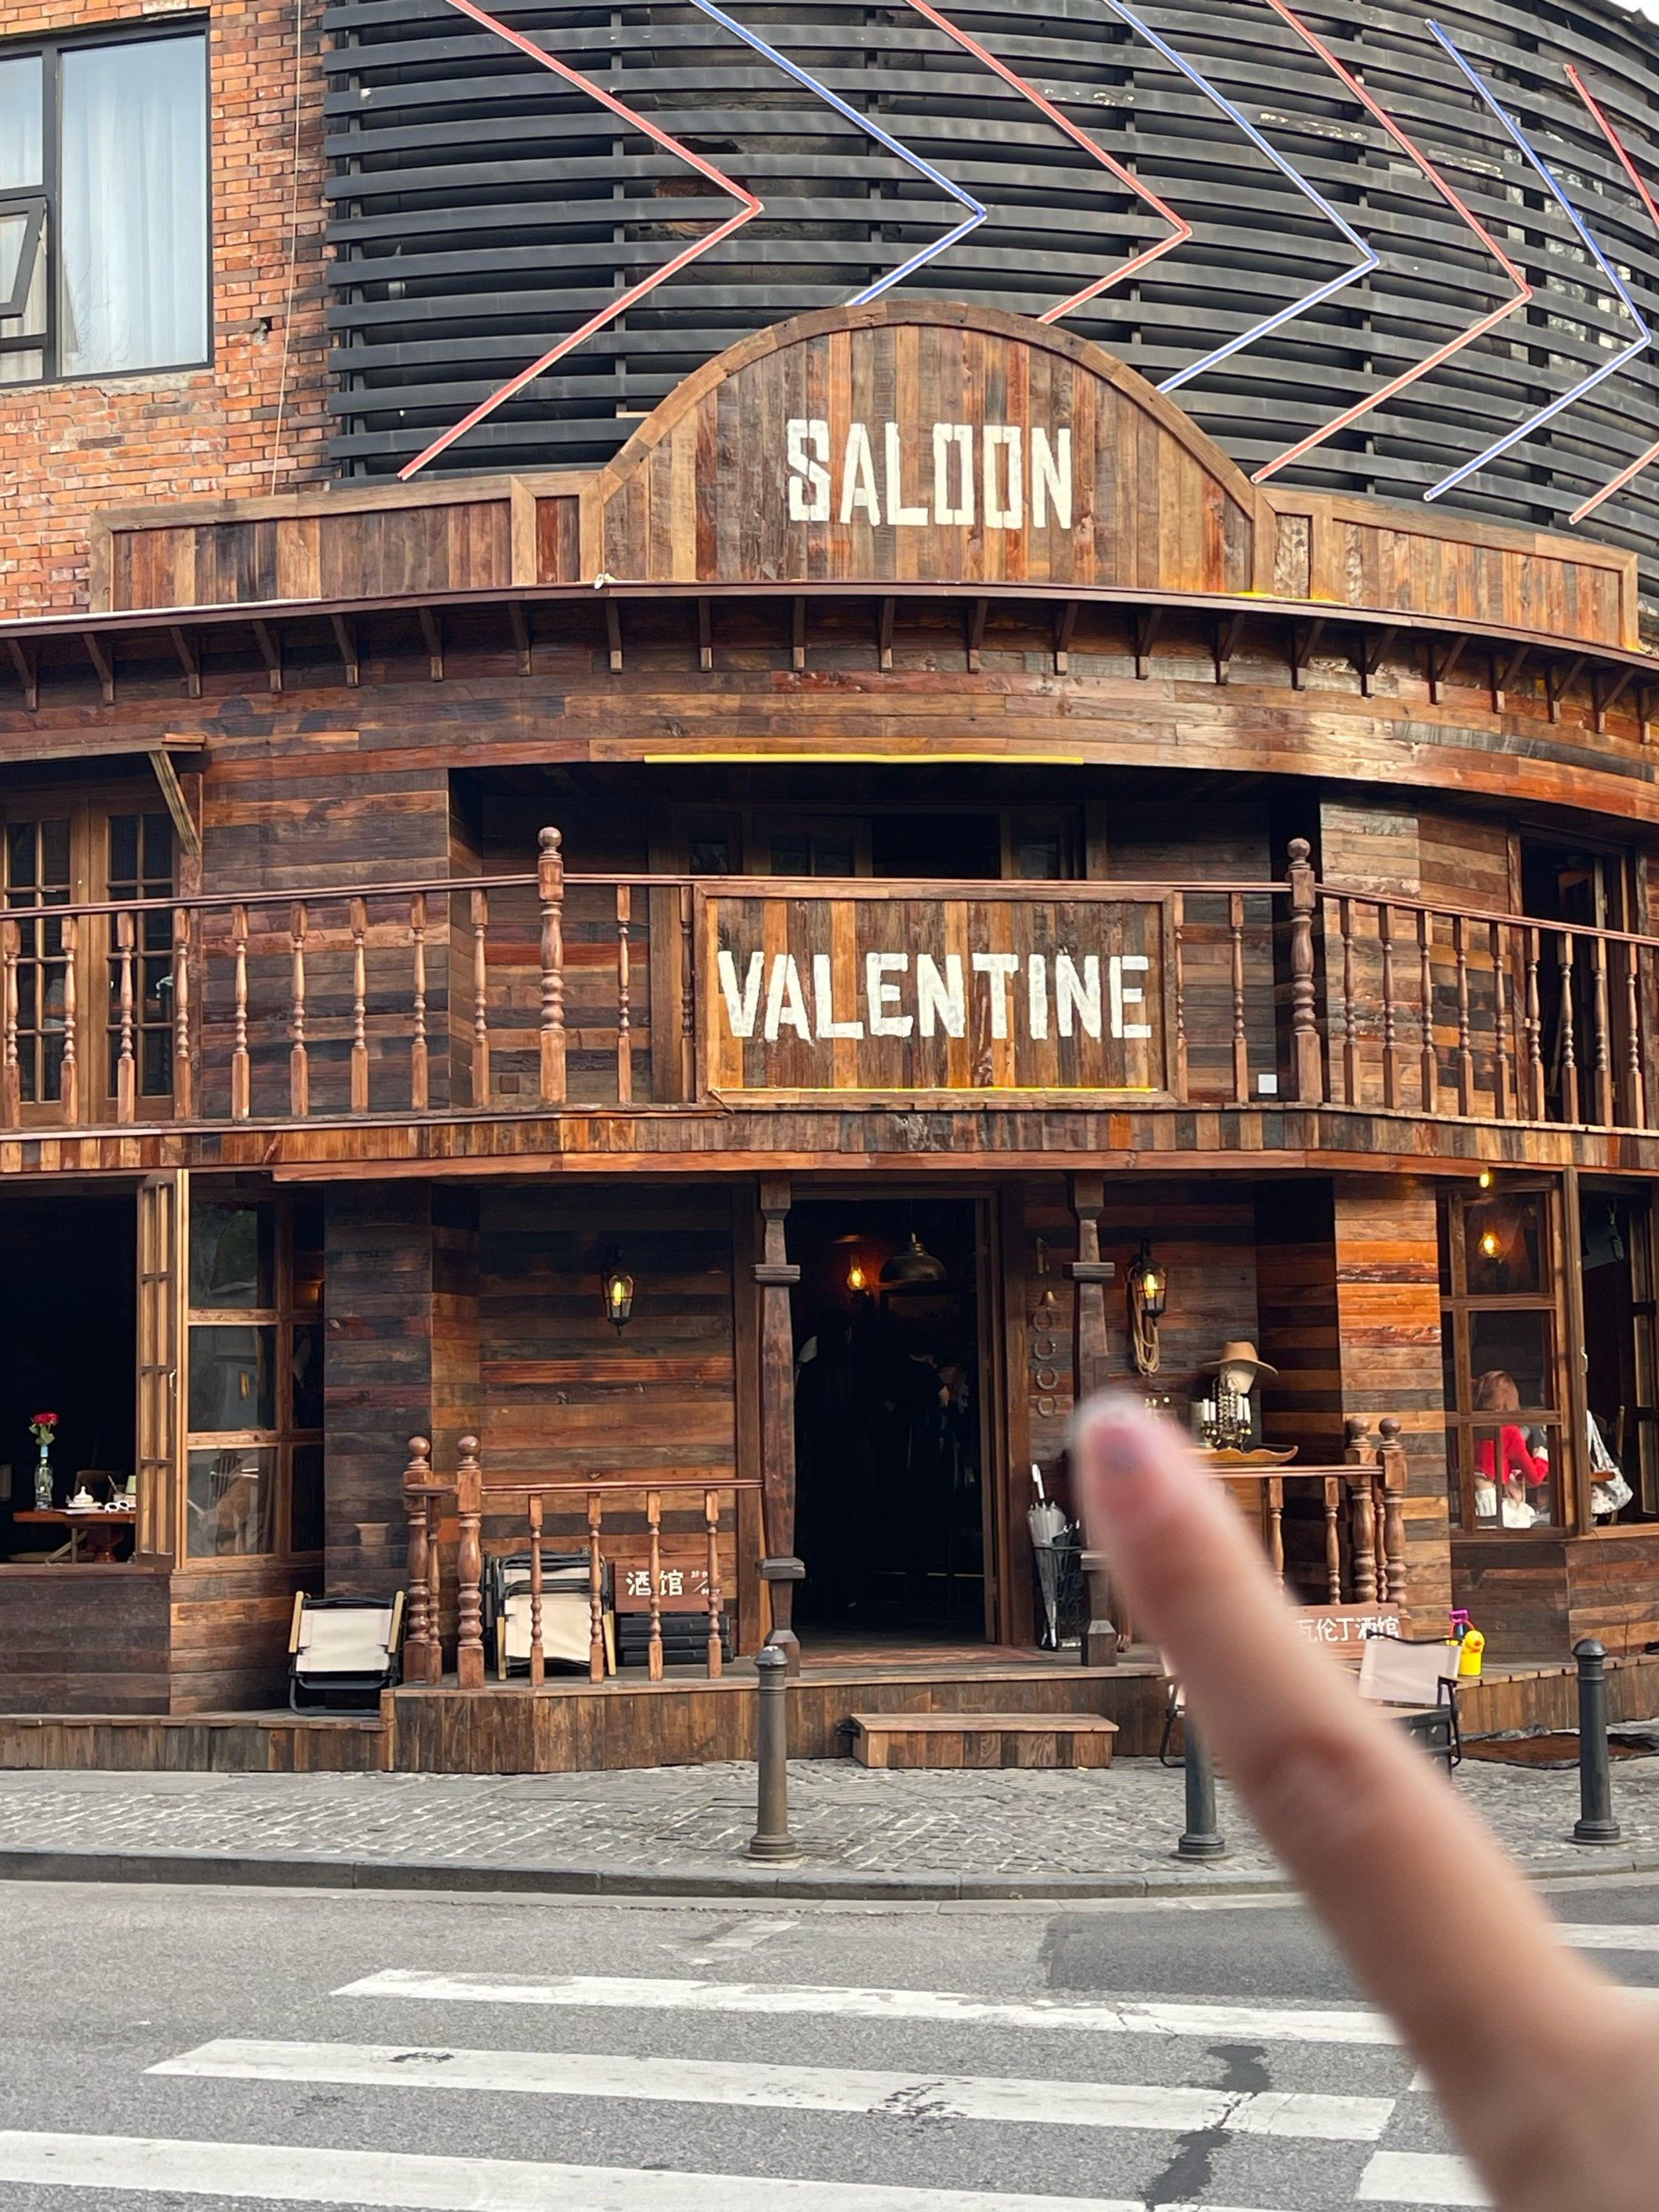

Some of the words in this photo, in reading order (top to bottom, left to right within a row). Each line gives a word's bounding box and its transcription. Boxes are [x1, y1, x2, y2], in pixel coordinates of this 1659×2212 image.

[787, 419, 1072, 529] SALOON
[718, 950, 1152, 1042] VALENTINE
[625, 1569, 684, 1596] 酒馆
